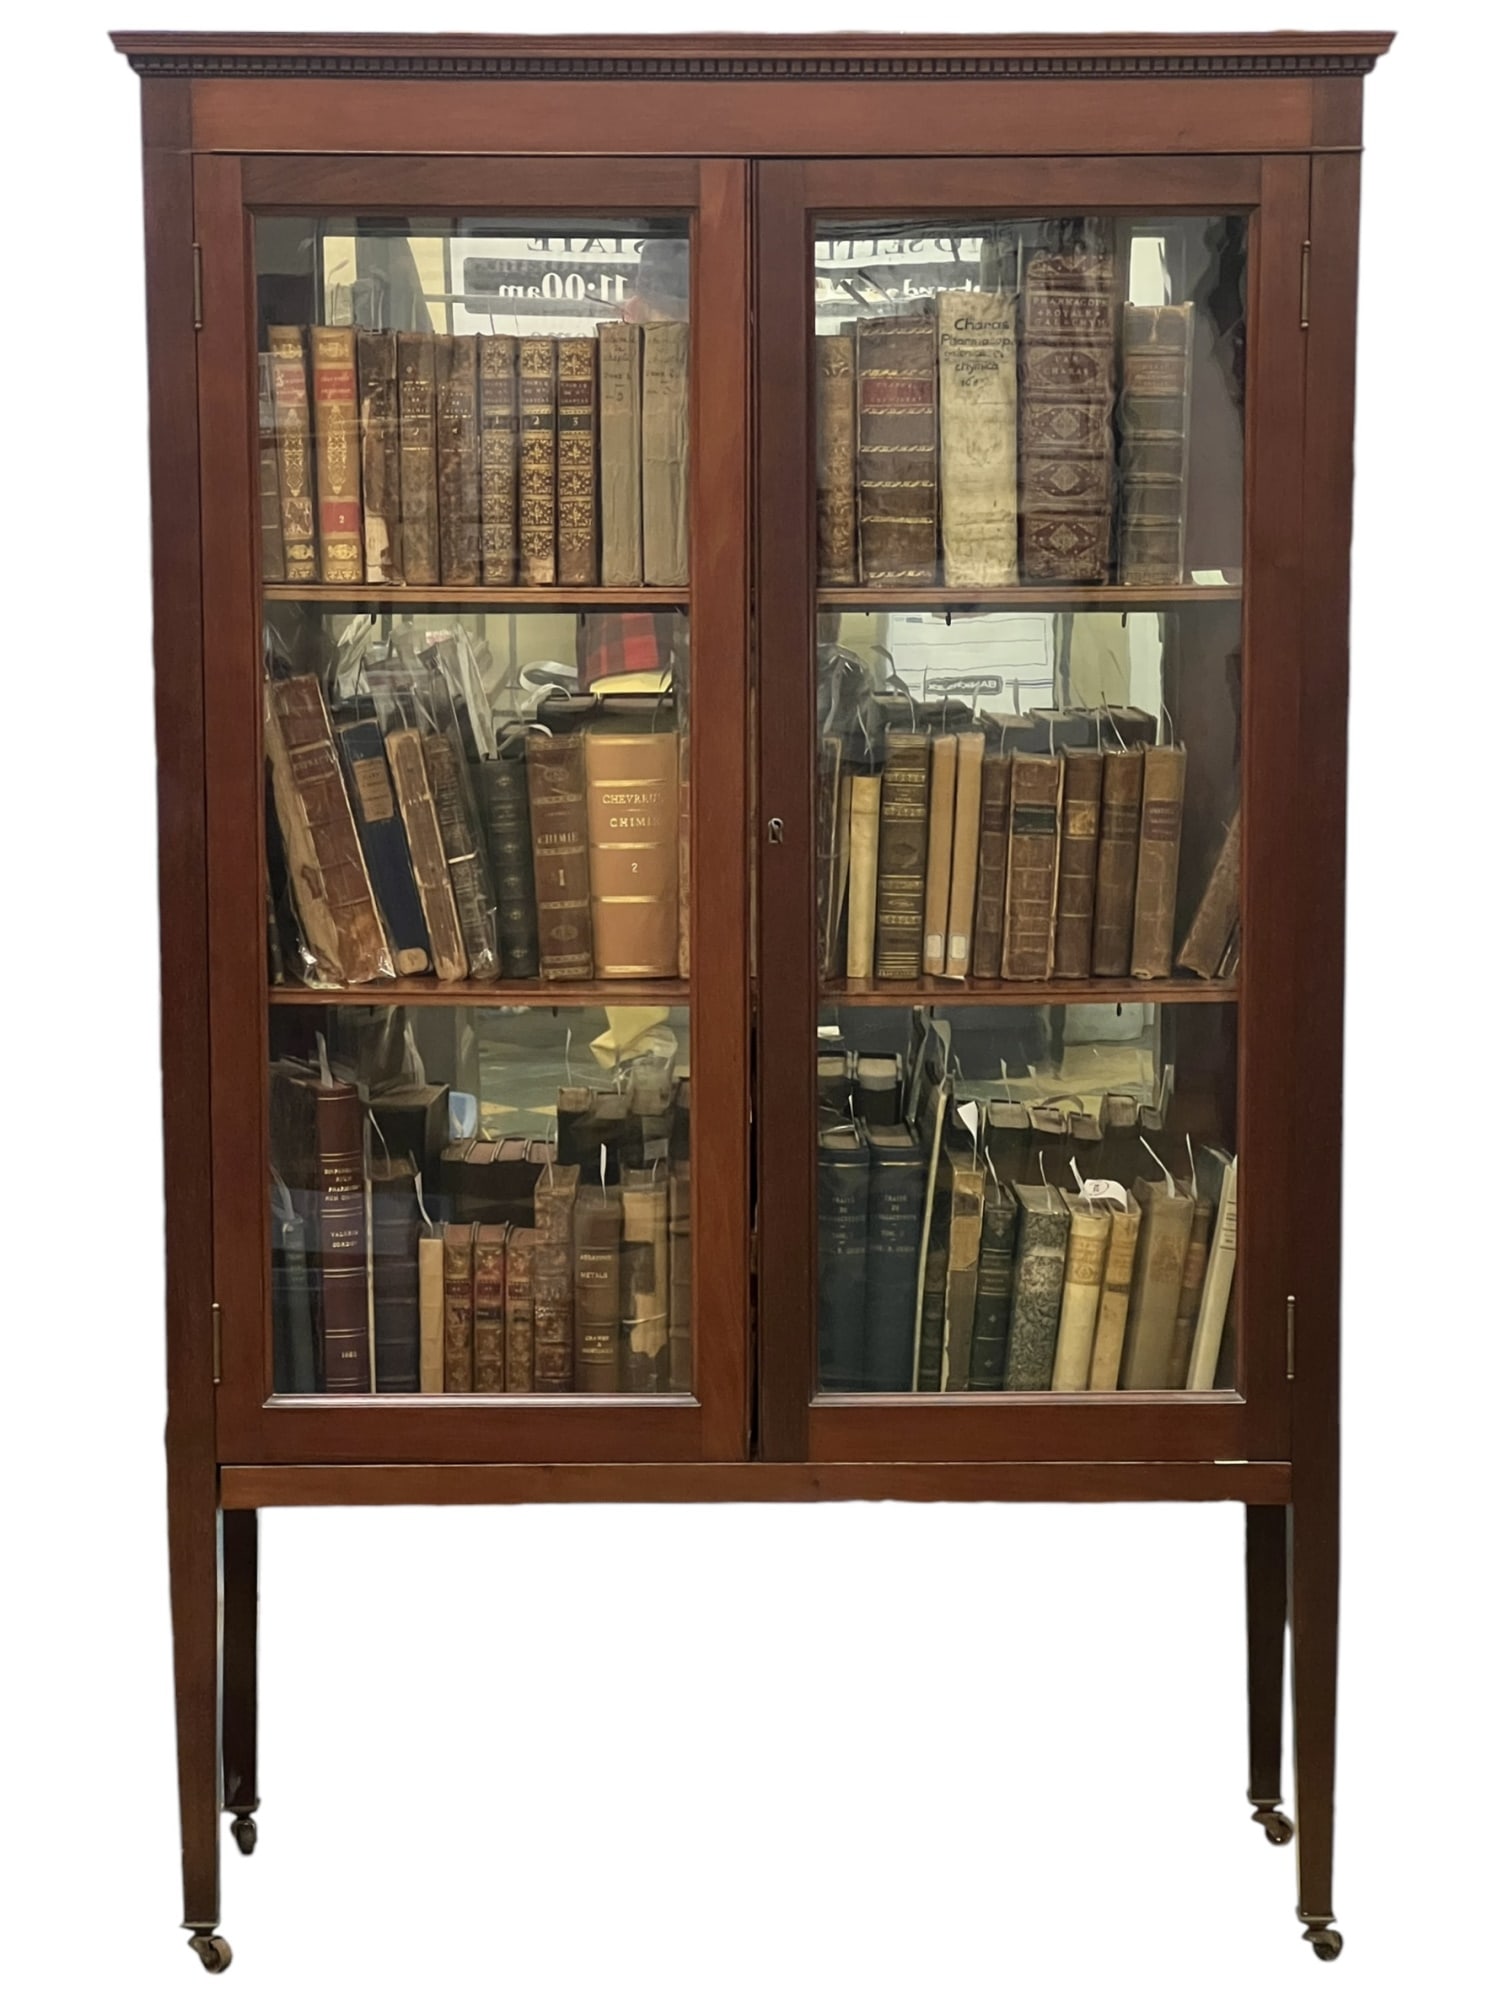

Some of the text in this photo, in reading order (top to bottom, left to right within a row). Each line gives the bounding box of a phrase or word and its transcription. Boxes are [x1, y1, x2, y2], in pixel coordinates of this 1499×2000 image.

[953, 317, 1010, 331] Charas
[533, 415, 540, 426] 2
[573, 416, 580, 427] 3
[631, 861, 639, 873] 2
